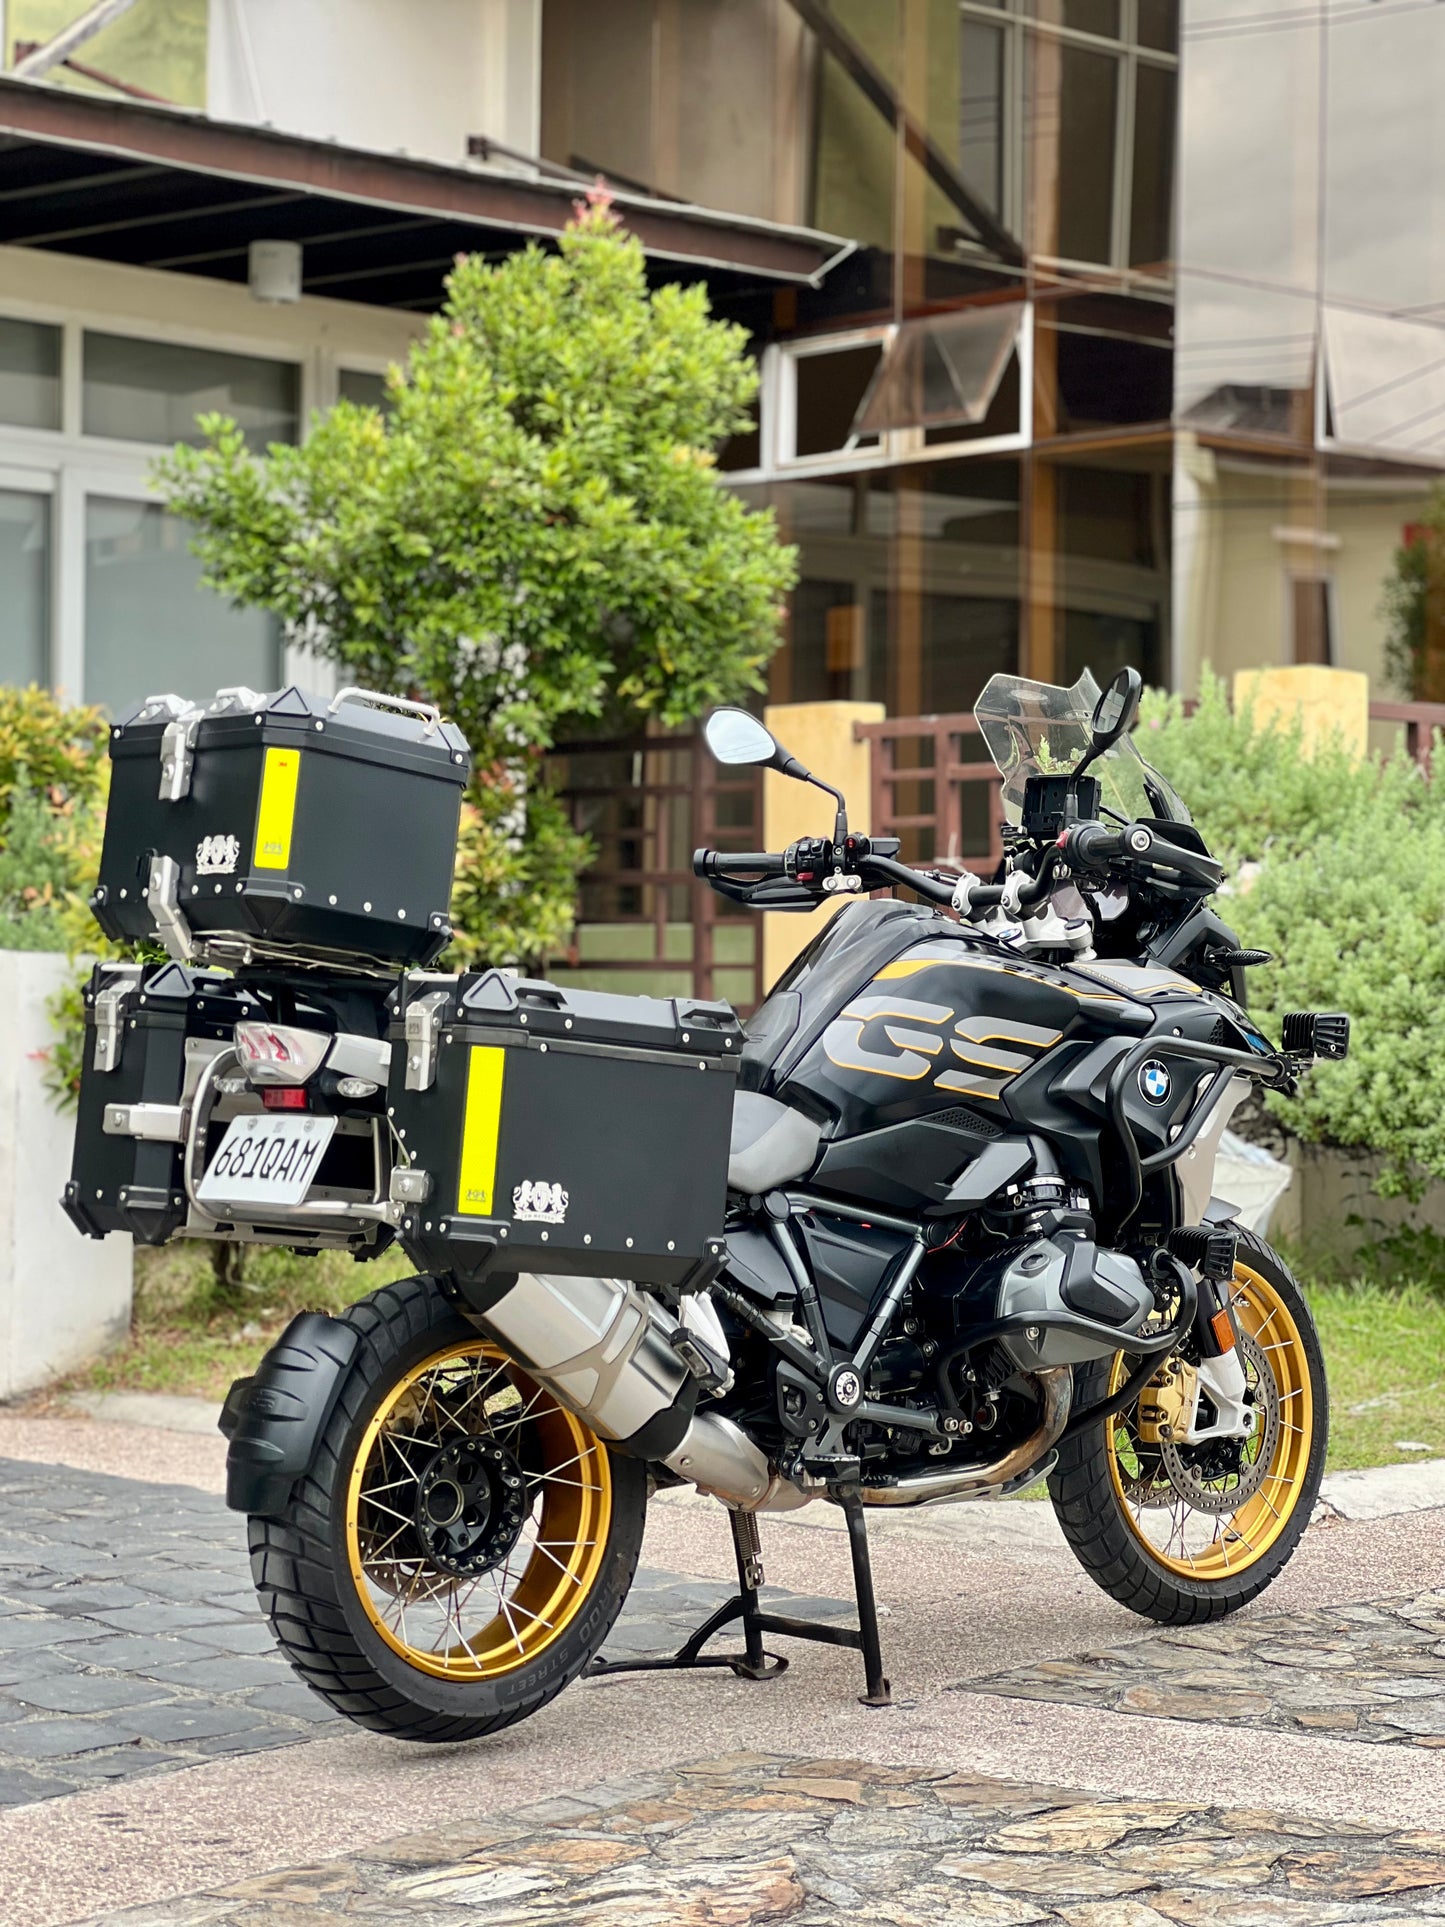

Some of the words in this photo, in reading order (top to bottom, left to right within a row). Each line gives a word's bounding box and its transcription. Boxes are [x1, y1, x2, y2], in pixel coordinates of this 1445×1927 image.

[823, 995, 1063, 1100] GS
[213, 1136, 321, 1183] 681QAM
[508, 1649, 569, 1695] STREET
